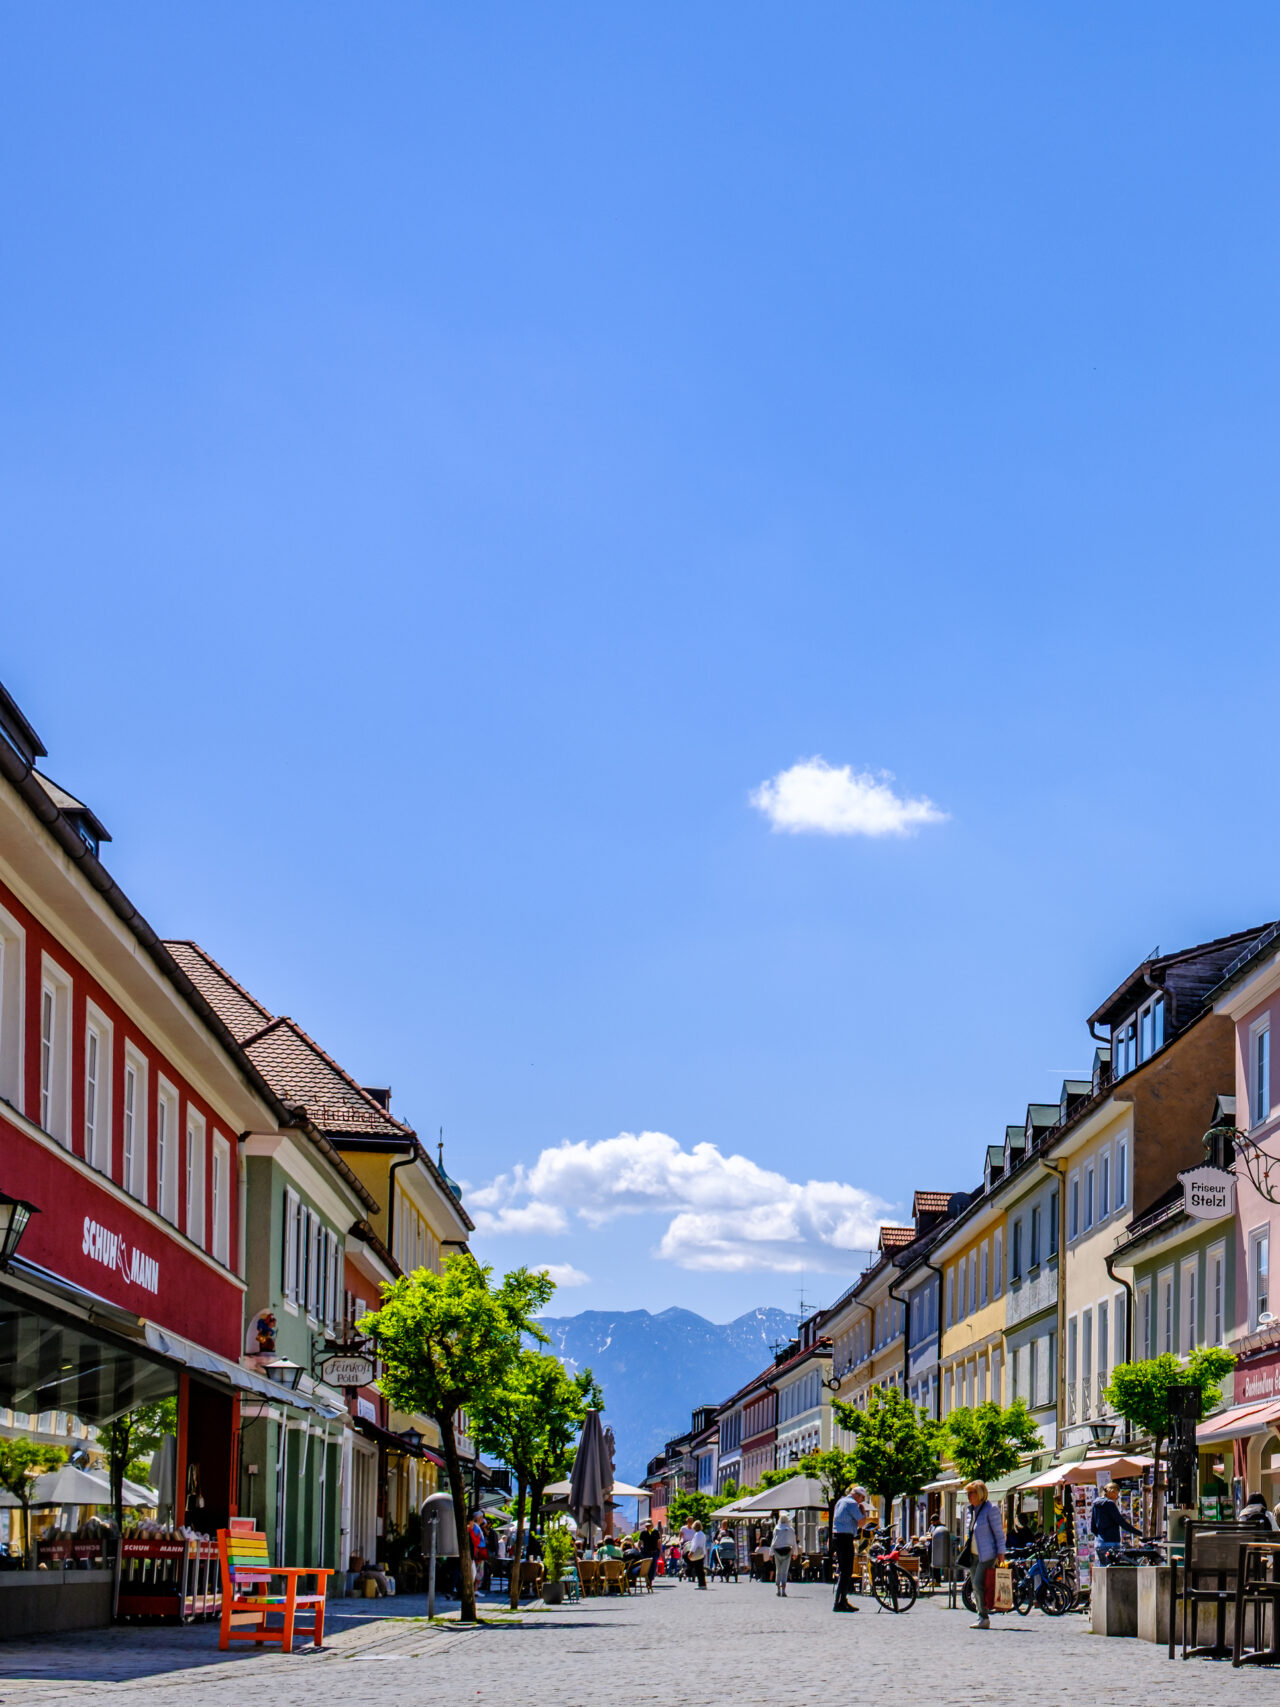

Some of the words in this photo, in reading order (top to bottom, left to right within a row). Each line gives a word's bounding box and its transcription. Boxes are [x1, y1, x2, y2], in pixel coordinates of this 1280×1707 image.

[1191, 1182, 1226, 1193] Friseur
[1191, 1194, 1226, 1207] Stelzl
[82, 1216, 118, 1271] SCHUH
[130, 1247, 159, 1295] MANN
[124, 1544, 150, 1552] SCHUH
[159, 1545, 184, 1553] MANN
